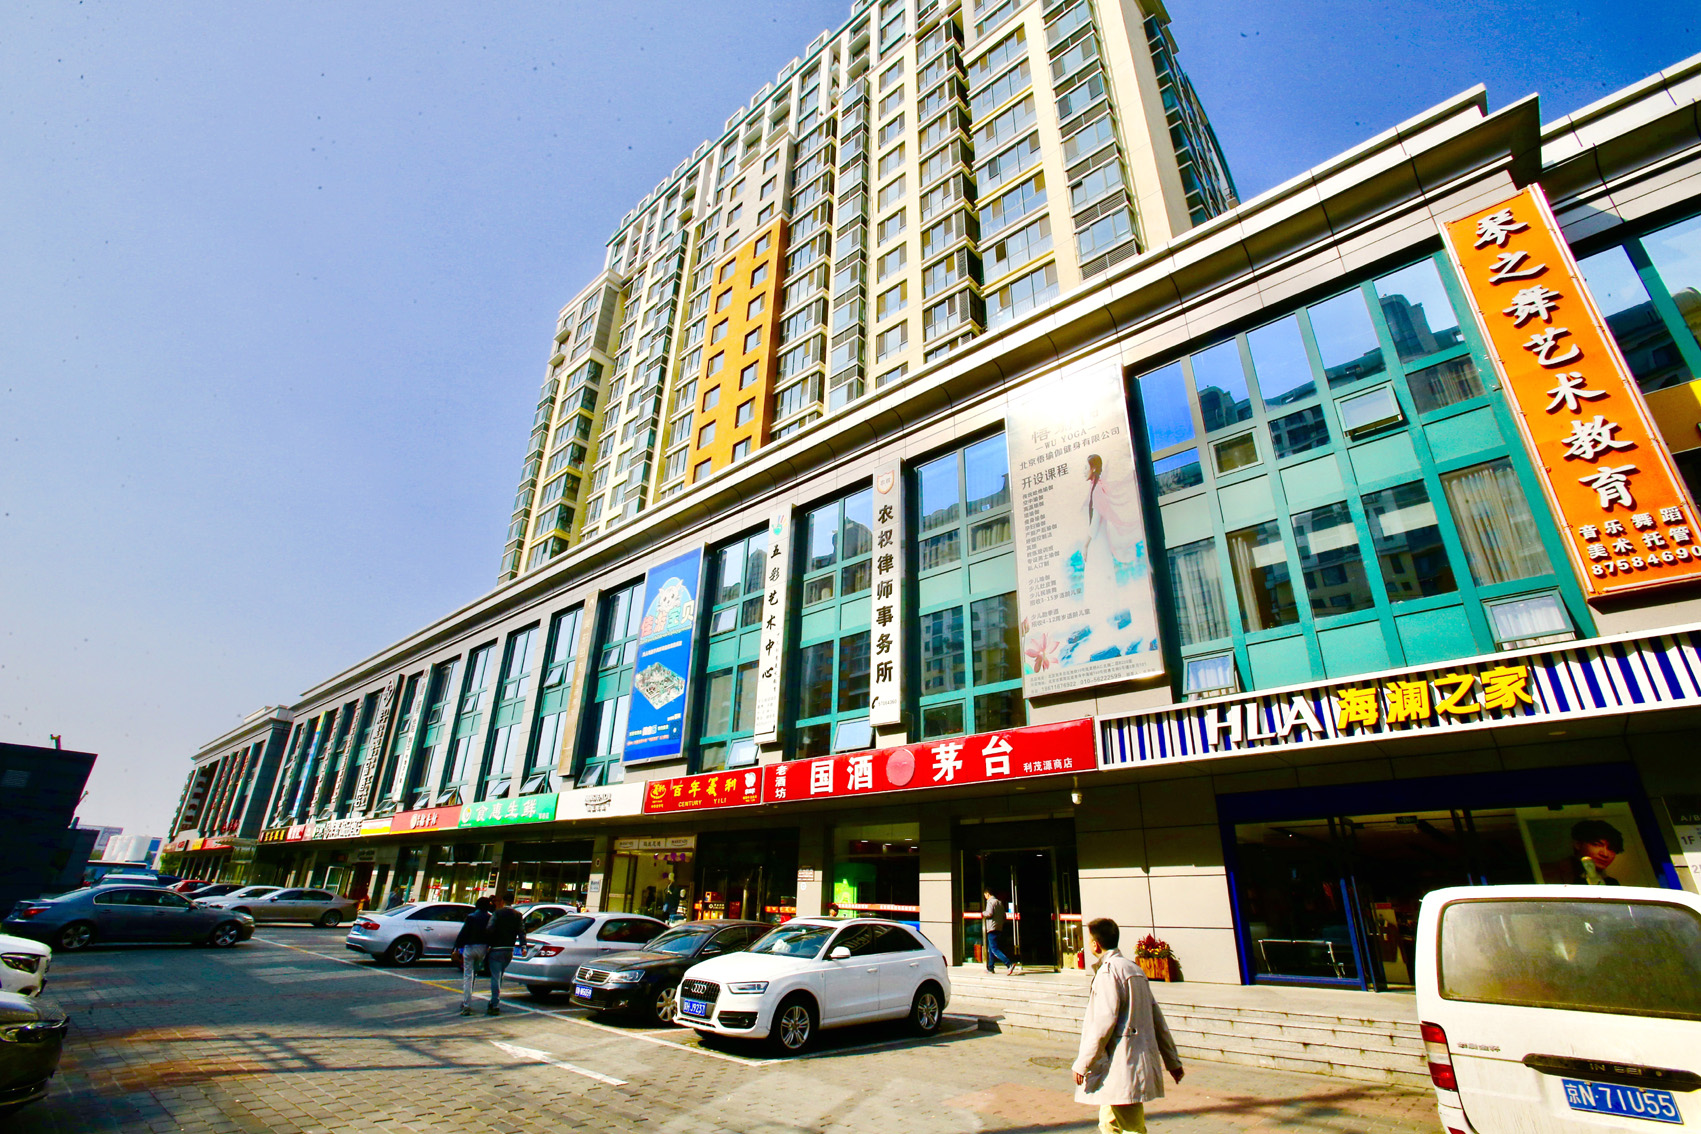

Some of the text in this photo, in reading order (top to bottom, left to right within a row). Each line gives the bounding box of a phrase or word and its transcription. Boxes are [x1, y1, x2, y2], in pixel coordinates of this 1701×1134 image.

[1473, 207, 1636, 510] 琴之舞艺术教育
[1019, 426, 1120, 470] 北京悟瑜伽健身有限公司
[1045, 429, 1087, 449] WU YOGA
[1021, 463, 1069, 490] 开设课程
[1578, 506, 1684, 541] 音乐舞蹈
[1586, 526, 1692, 560] 美术托管
[1591, 545, 1701, 576] 87584690
[761, 543, 782, 679] 五彩艺术中心
[875, 504, 895, 684] 农权律师事务所
[1205, 665, 1535, 747] HLA 海澜之家
[774, 764, 787, 799] 老酒坊
[809, 755, 874, 796] 国酒
[931, 735, 1014, 782] 茅台
[1022, 757, 1073, 773] 利茂源商店
[678, 800, 702, 808] CENTURY
[1680, 835, 1696, 845] 1F
